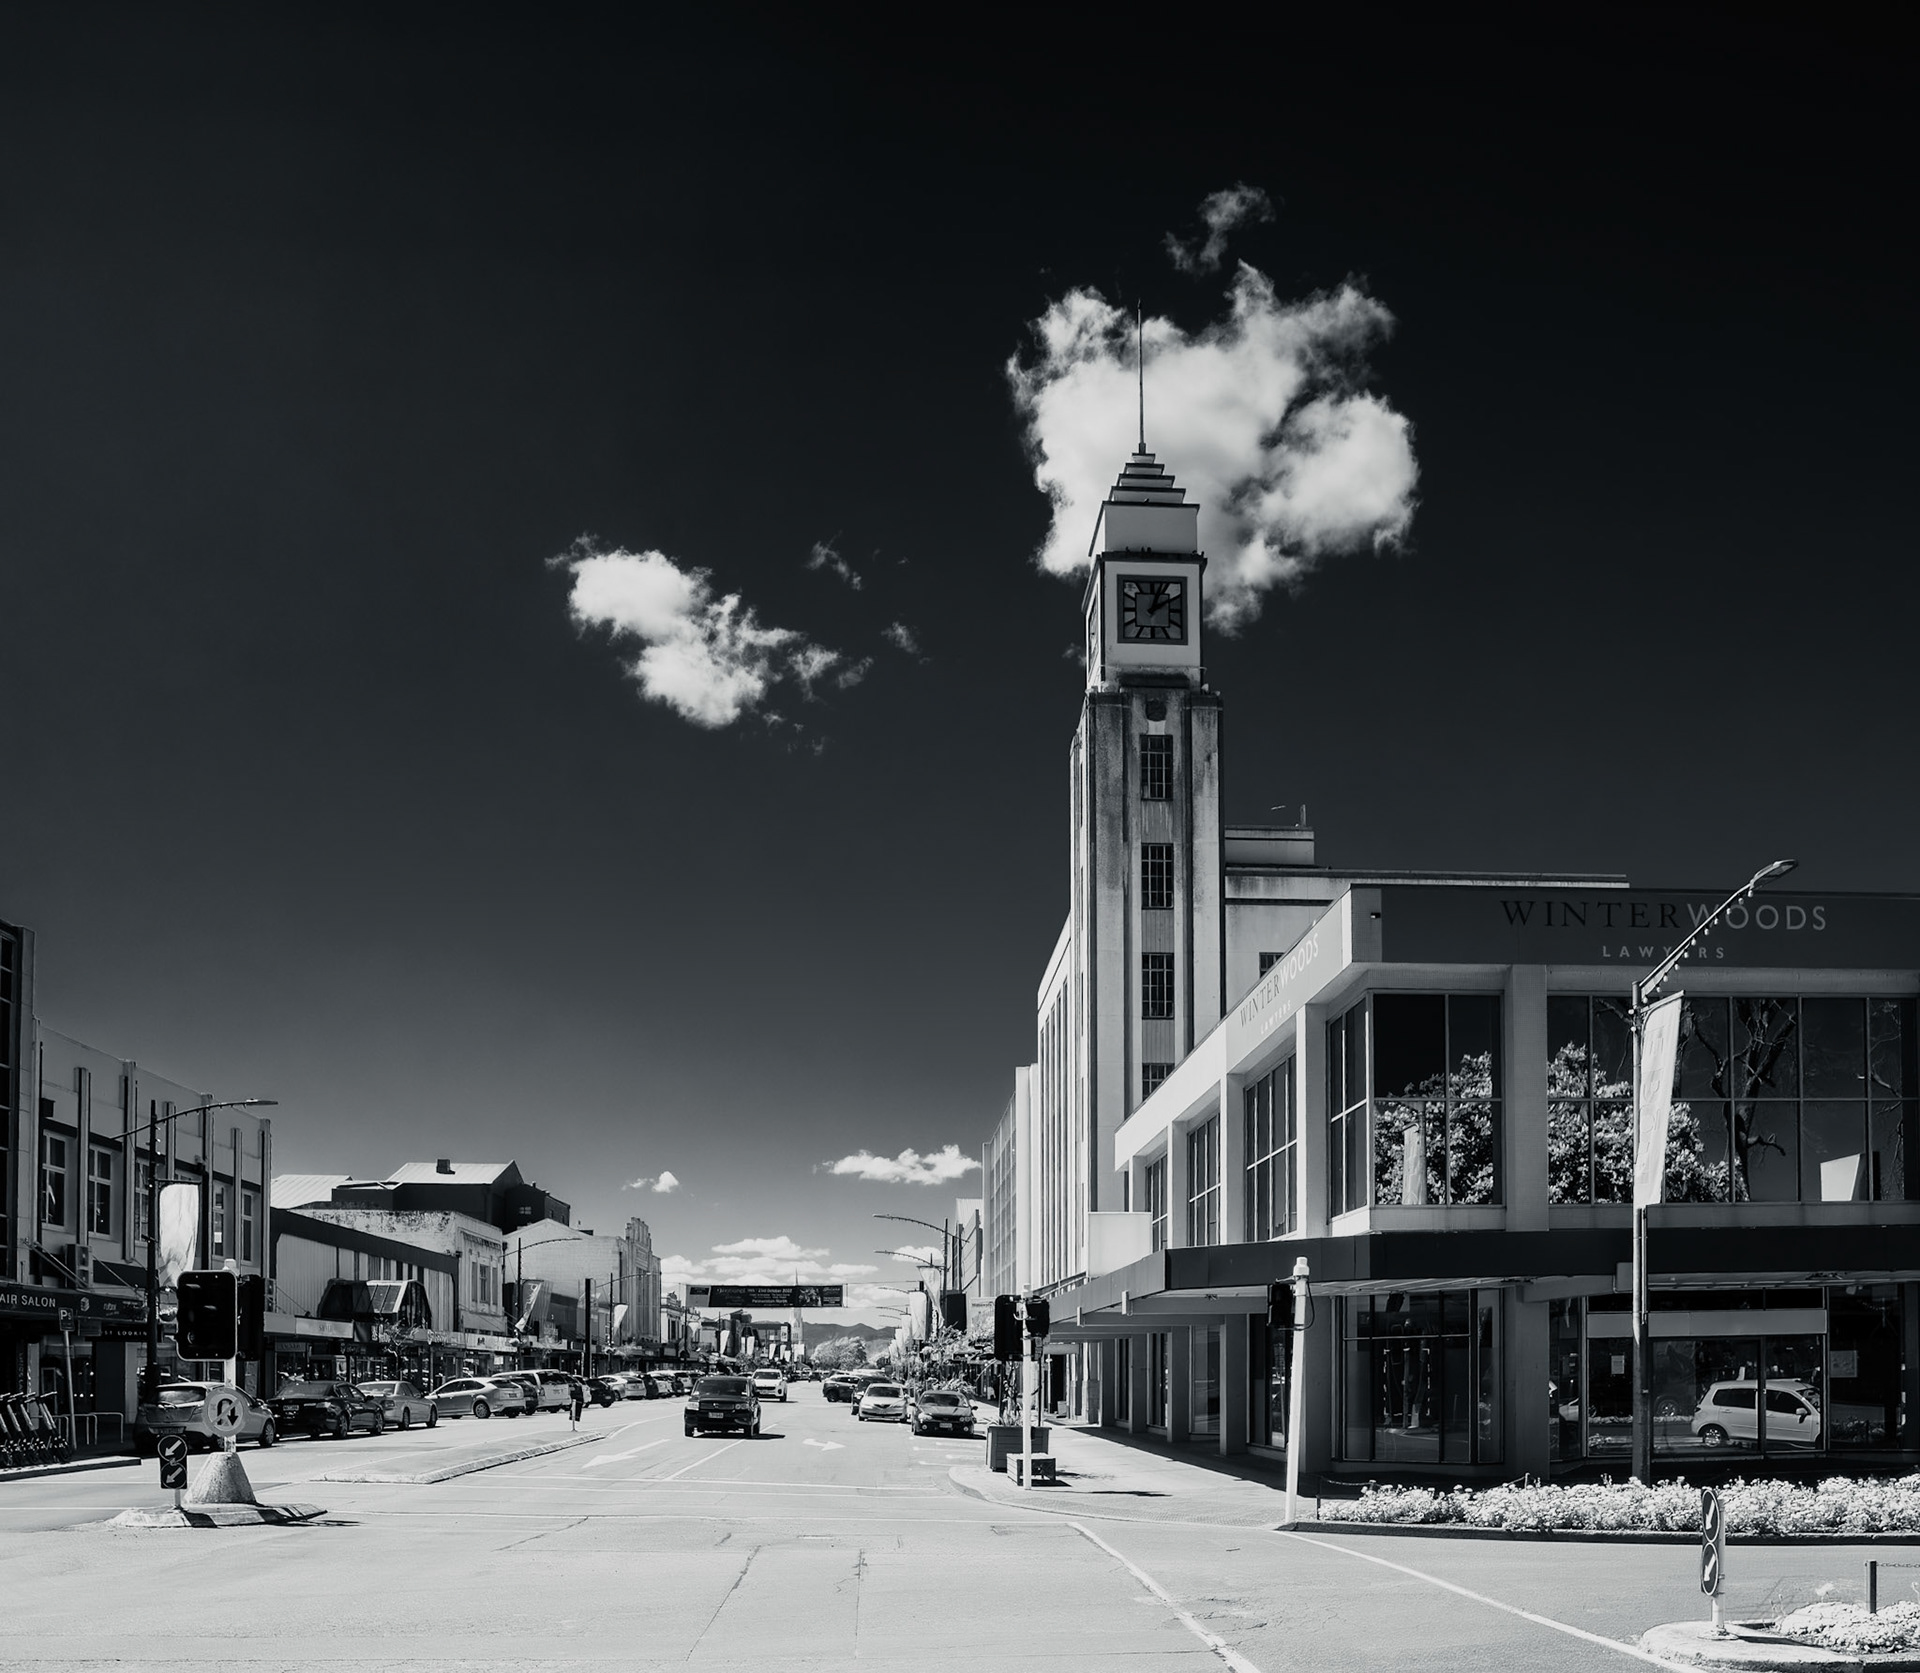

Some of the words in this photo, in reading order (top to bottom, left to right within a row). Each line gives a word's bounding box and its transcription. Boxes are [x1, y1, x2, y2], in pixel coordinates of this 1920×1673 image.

[1502, 900, 1827, 931] WINTERWOODS
[1602, 945, 1724, 959] LAWYRS
[0, 1293, 17, 1305] AIR
[21, 1294, 56, 1308] SALON
